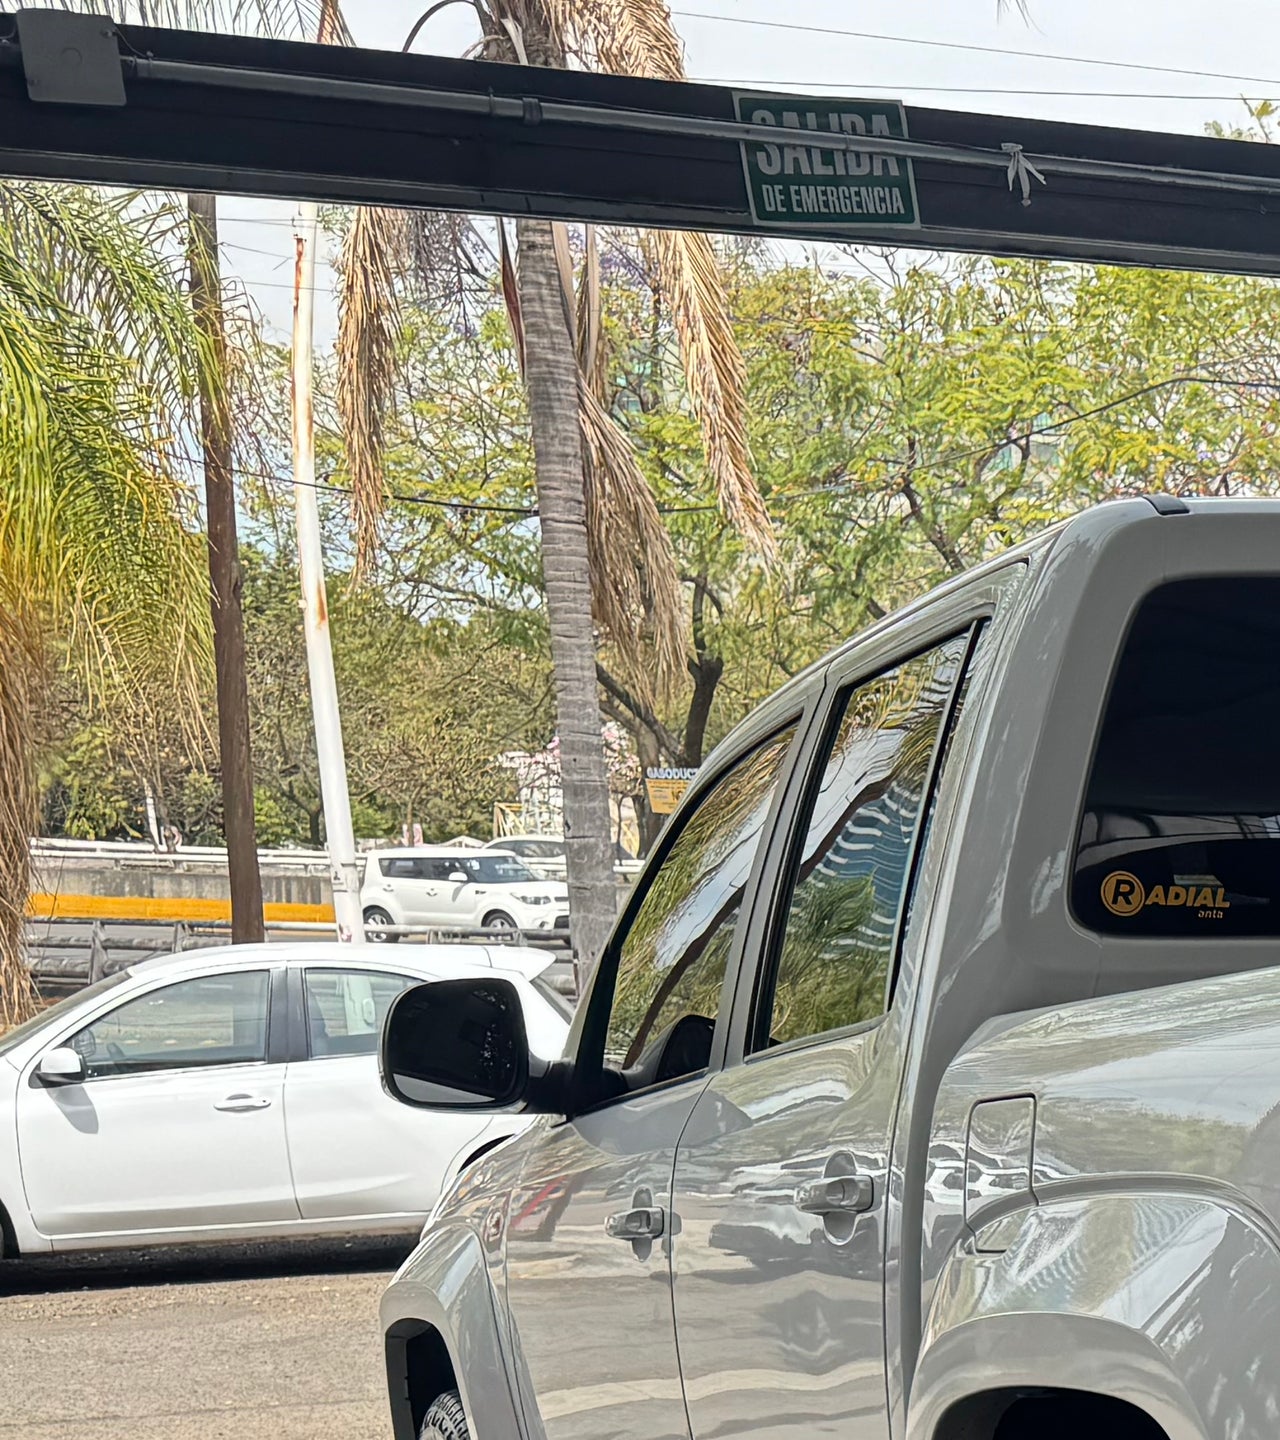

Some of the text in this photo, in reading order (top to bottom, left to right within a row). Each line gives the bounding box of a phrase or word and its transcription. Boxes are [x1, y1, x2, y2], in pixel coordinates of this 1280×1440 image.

[751, 110, 900, 177] SALIDA
[762, 184, 905, 215] DE EMERGENCIA
[1106, 874, 1230, 911] RADIAL
